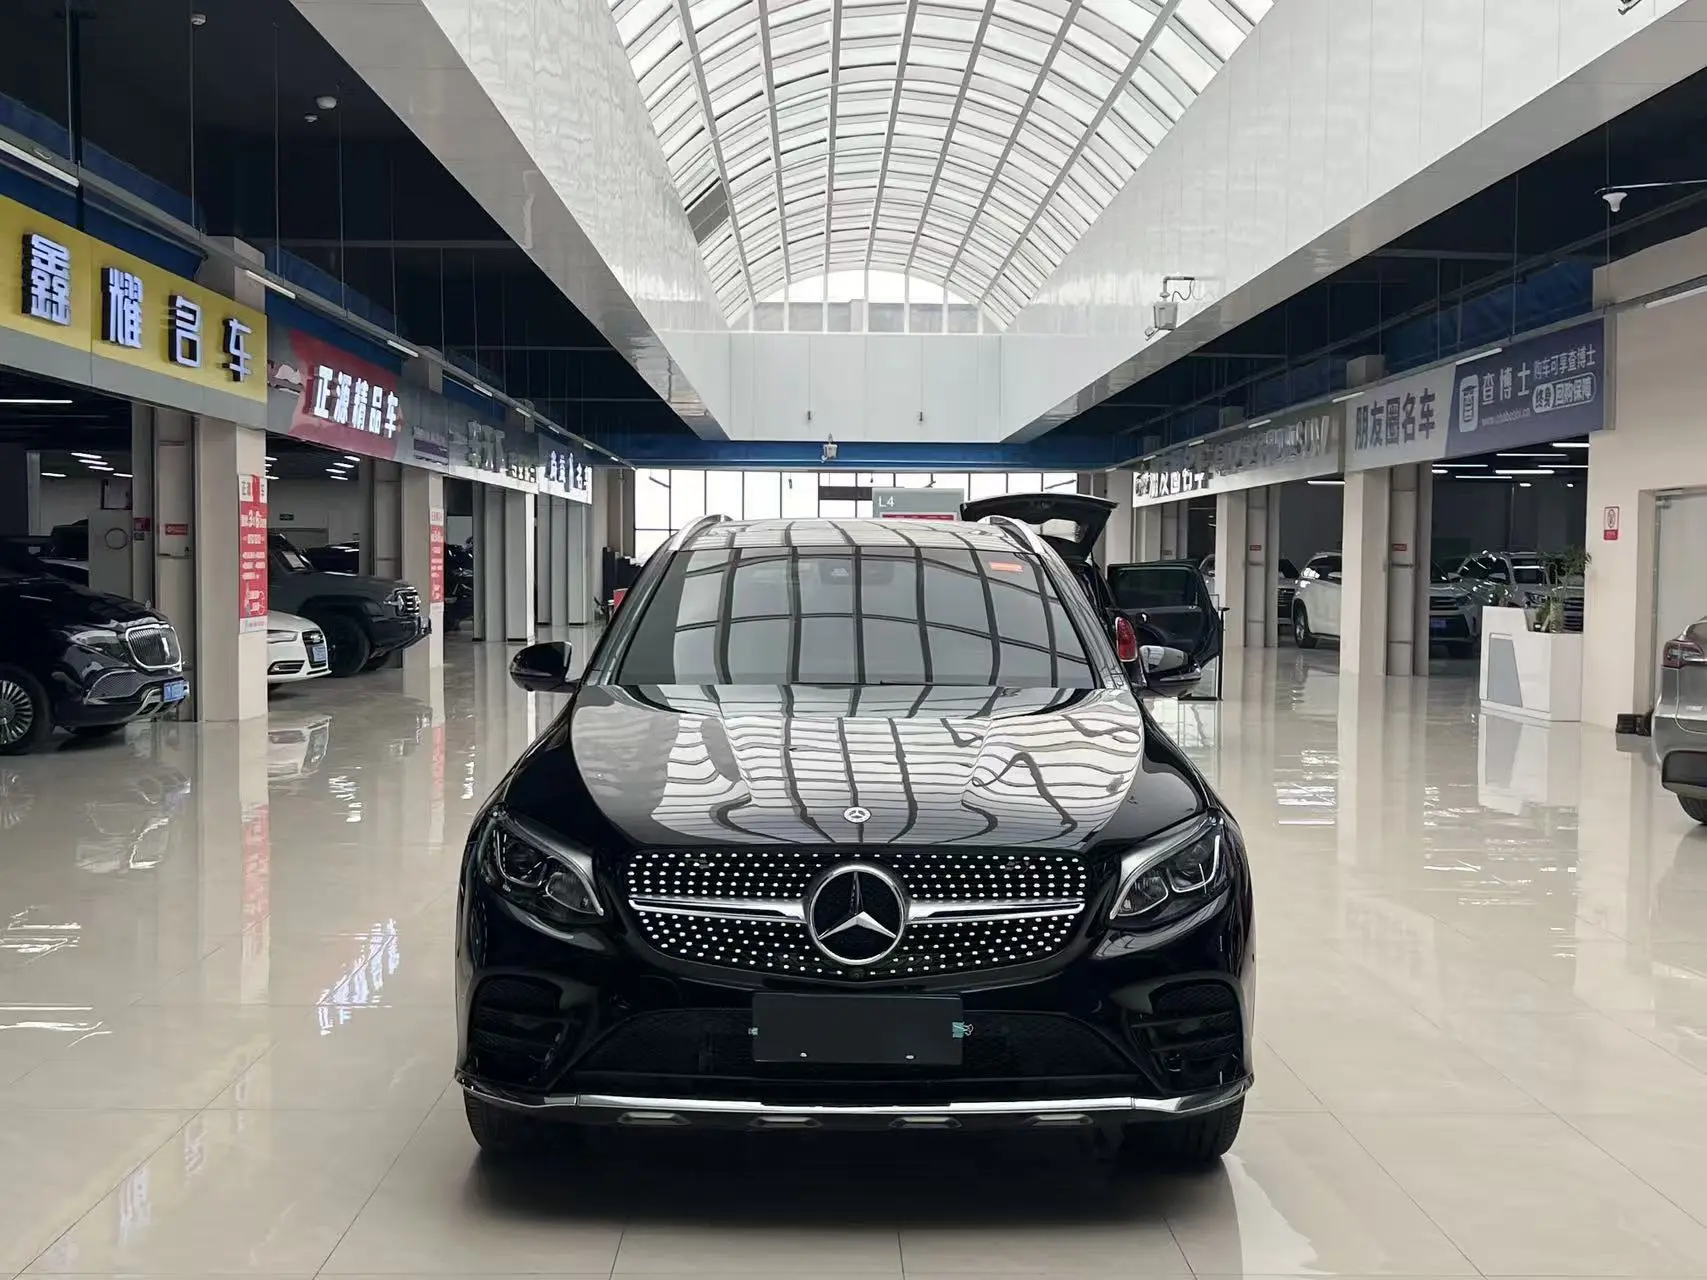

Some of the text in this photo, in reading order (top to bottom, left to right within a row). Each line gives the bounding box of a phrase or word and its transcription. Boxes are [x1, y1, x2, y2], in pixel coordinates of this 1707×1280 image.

[23, 233, 252, 382] 鑫耀名车
[1481, 362, 1531, 406] 查博士
[1354, 388, 1436, 451] 朋友圈名车
[878, 495, 895, 508] L4
